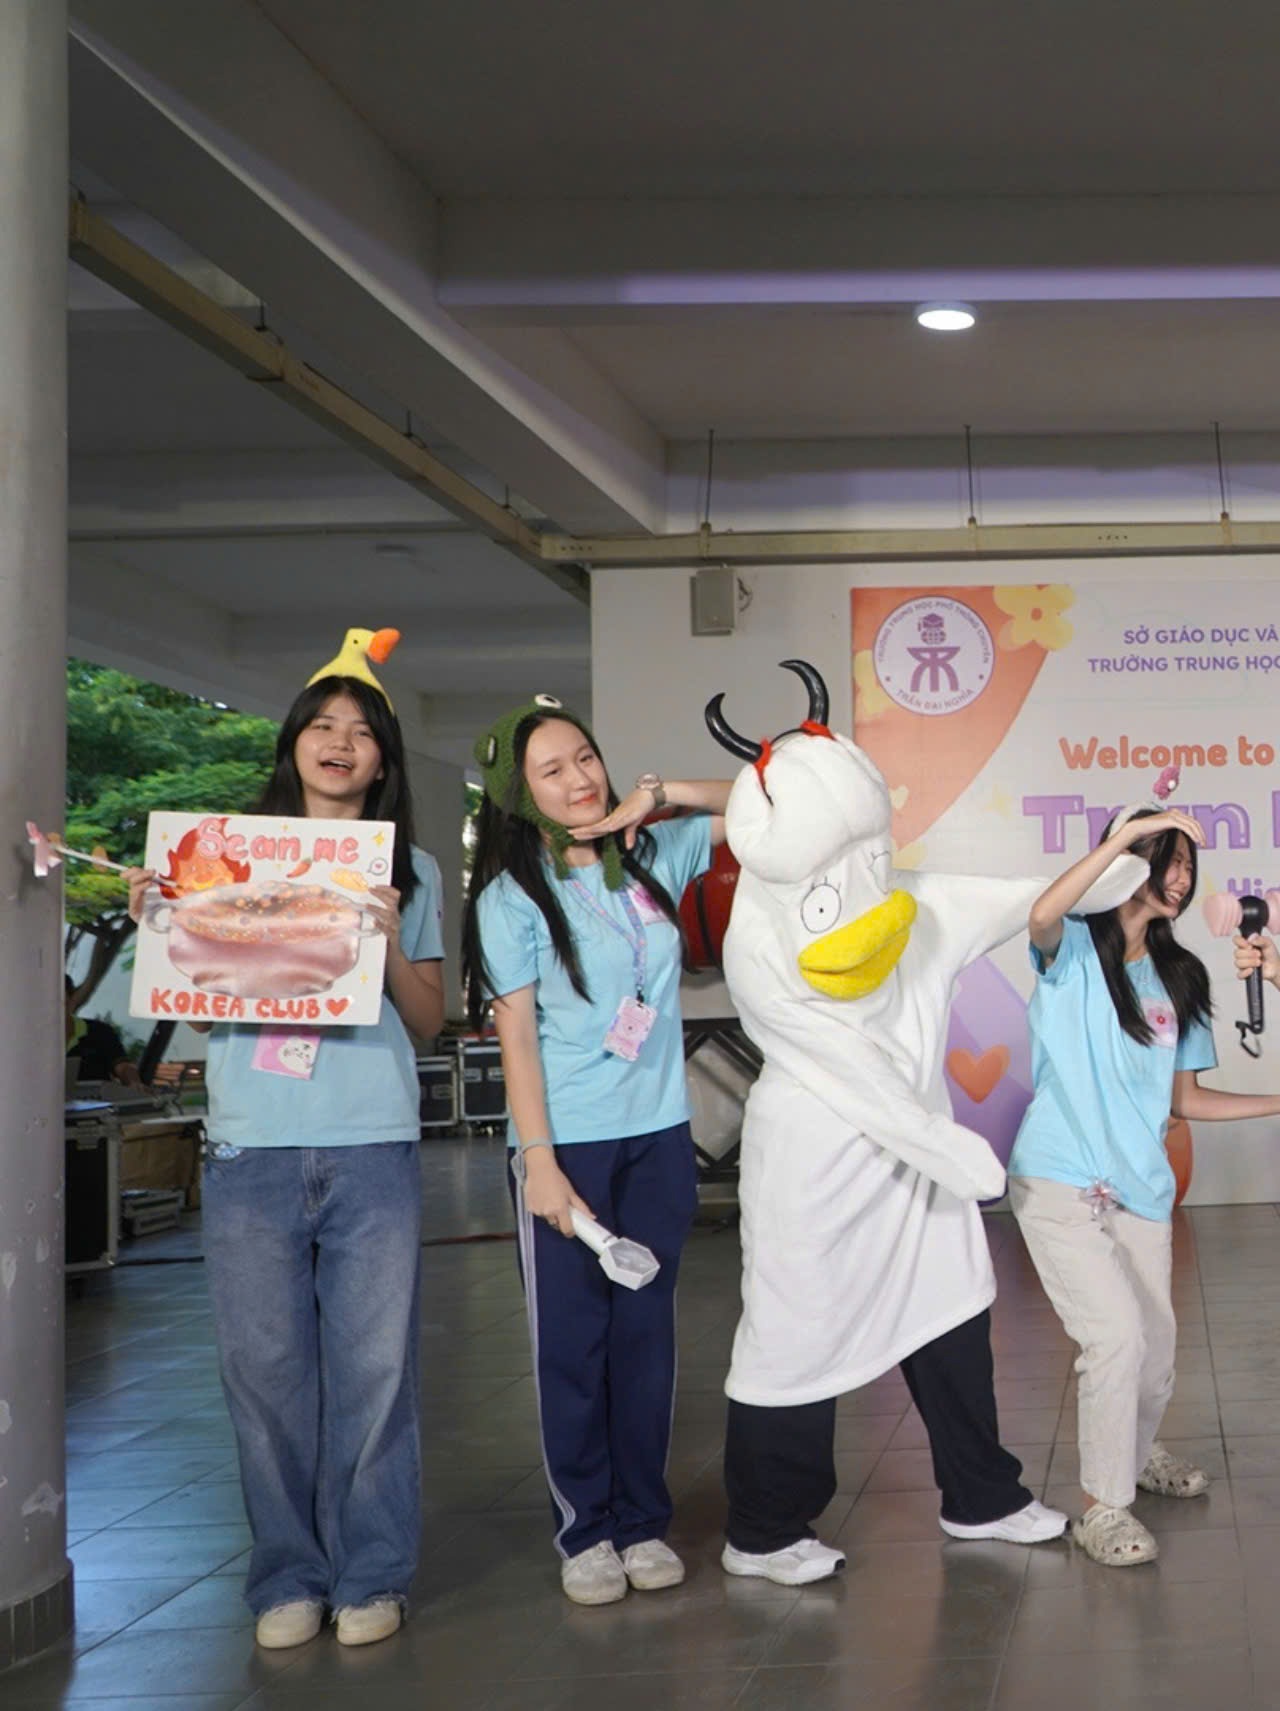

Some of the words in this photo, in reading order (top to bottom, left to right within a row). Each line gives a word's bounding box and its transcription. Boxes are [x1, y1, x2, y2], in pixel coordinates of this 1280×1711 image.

[1155, 625, 1205, 644] GIÁO
[1211, 627, 1250, 647] DỤC
[1255, 623, 1279, 642] VÀ
[1088, 654, 1168, 673] TRƯỜNG
[1174, 656, 1240, 671] TRUNG
[1059, 735, 1228, 769] Welcome
[1237, 735, 1275, 767] to
[199, 817, 301, 862] Scan
[313, 836, 360, 864] me
[1022, 795, 1251, 854] Trn
[151, 987, 246, 1018] KOREA
[255, 997, 321, 1019] CLUB
